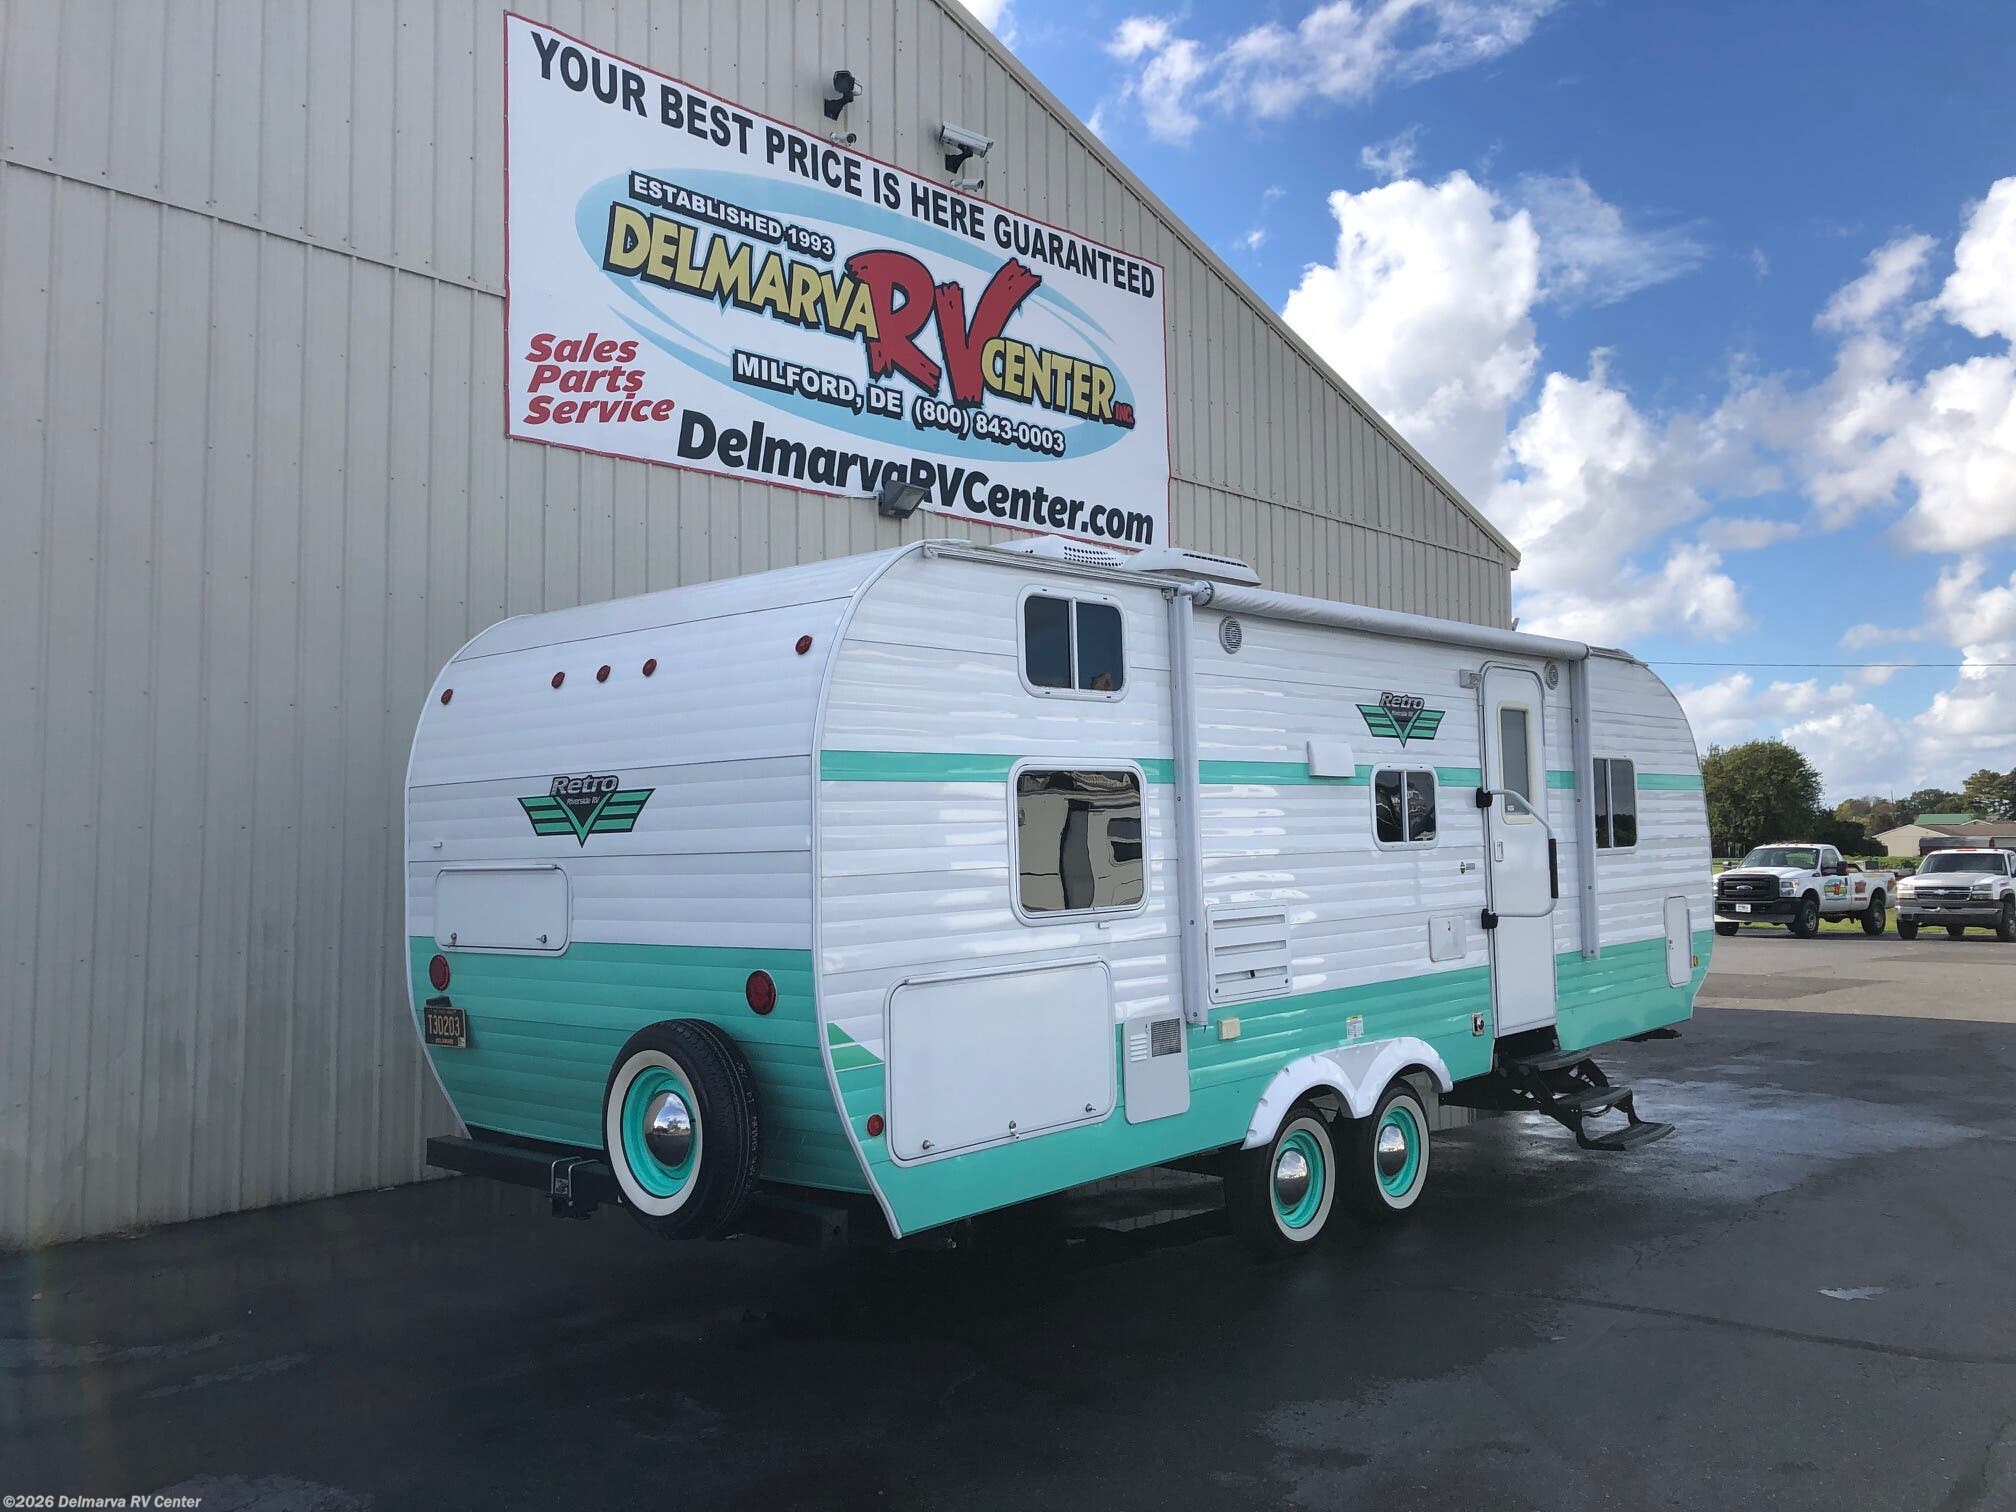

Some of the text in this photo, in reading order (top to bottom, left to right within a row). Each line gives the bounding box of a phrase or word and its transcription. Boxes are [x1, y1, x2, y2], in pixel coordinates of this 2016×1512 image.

[531, 30, 1155, 298] YOUR BEST PRICE IS HERE GUARANTEED
[632, 174, 834, 256] ESTABLISHED 1993
[604, 203, 879, 341] DELMARVA
[844, 249, 1043, 409] RV
[981, 338, 1115, 420] CENTER
[525, 332, 640, 363] Sales
[526, 364, 646, 393] Parts
[737, 353, 1065, 452] MILFORD, DE (800) 843-0003
[523, 393, 675, 425] Service
[677, 408, 1154, 546] DelmarvaRVCenter.com
[1380, 692, 1424, 710] Retro
[551, 775, 618, 796] Retro
